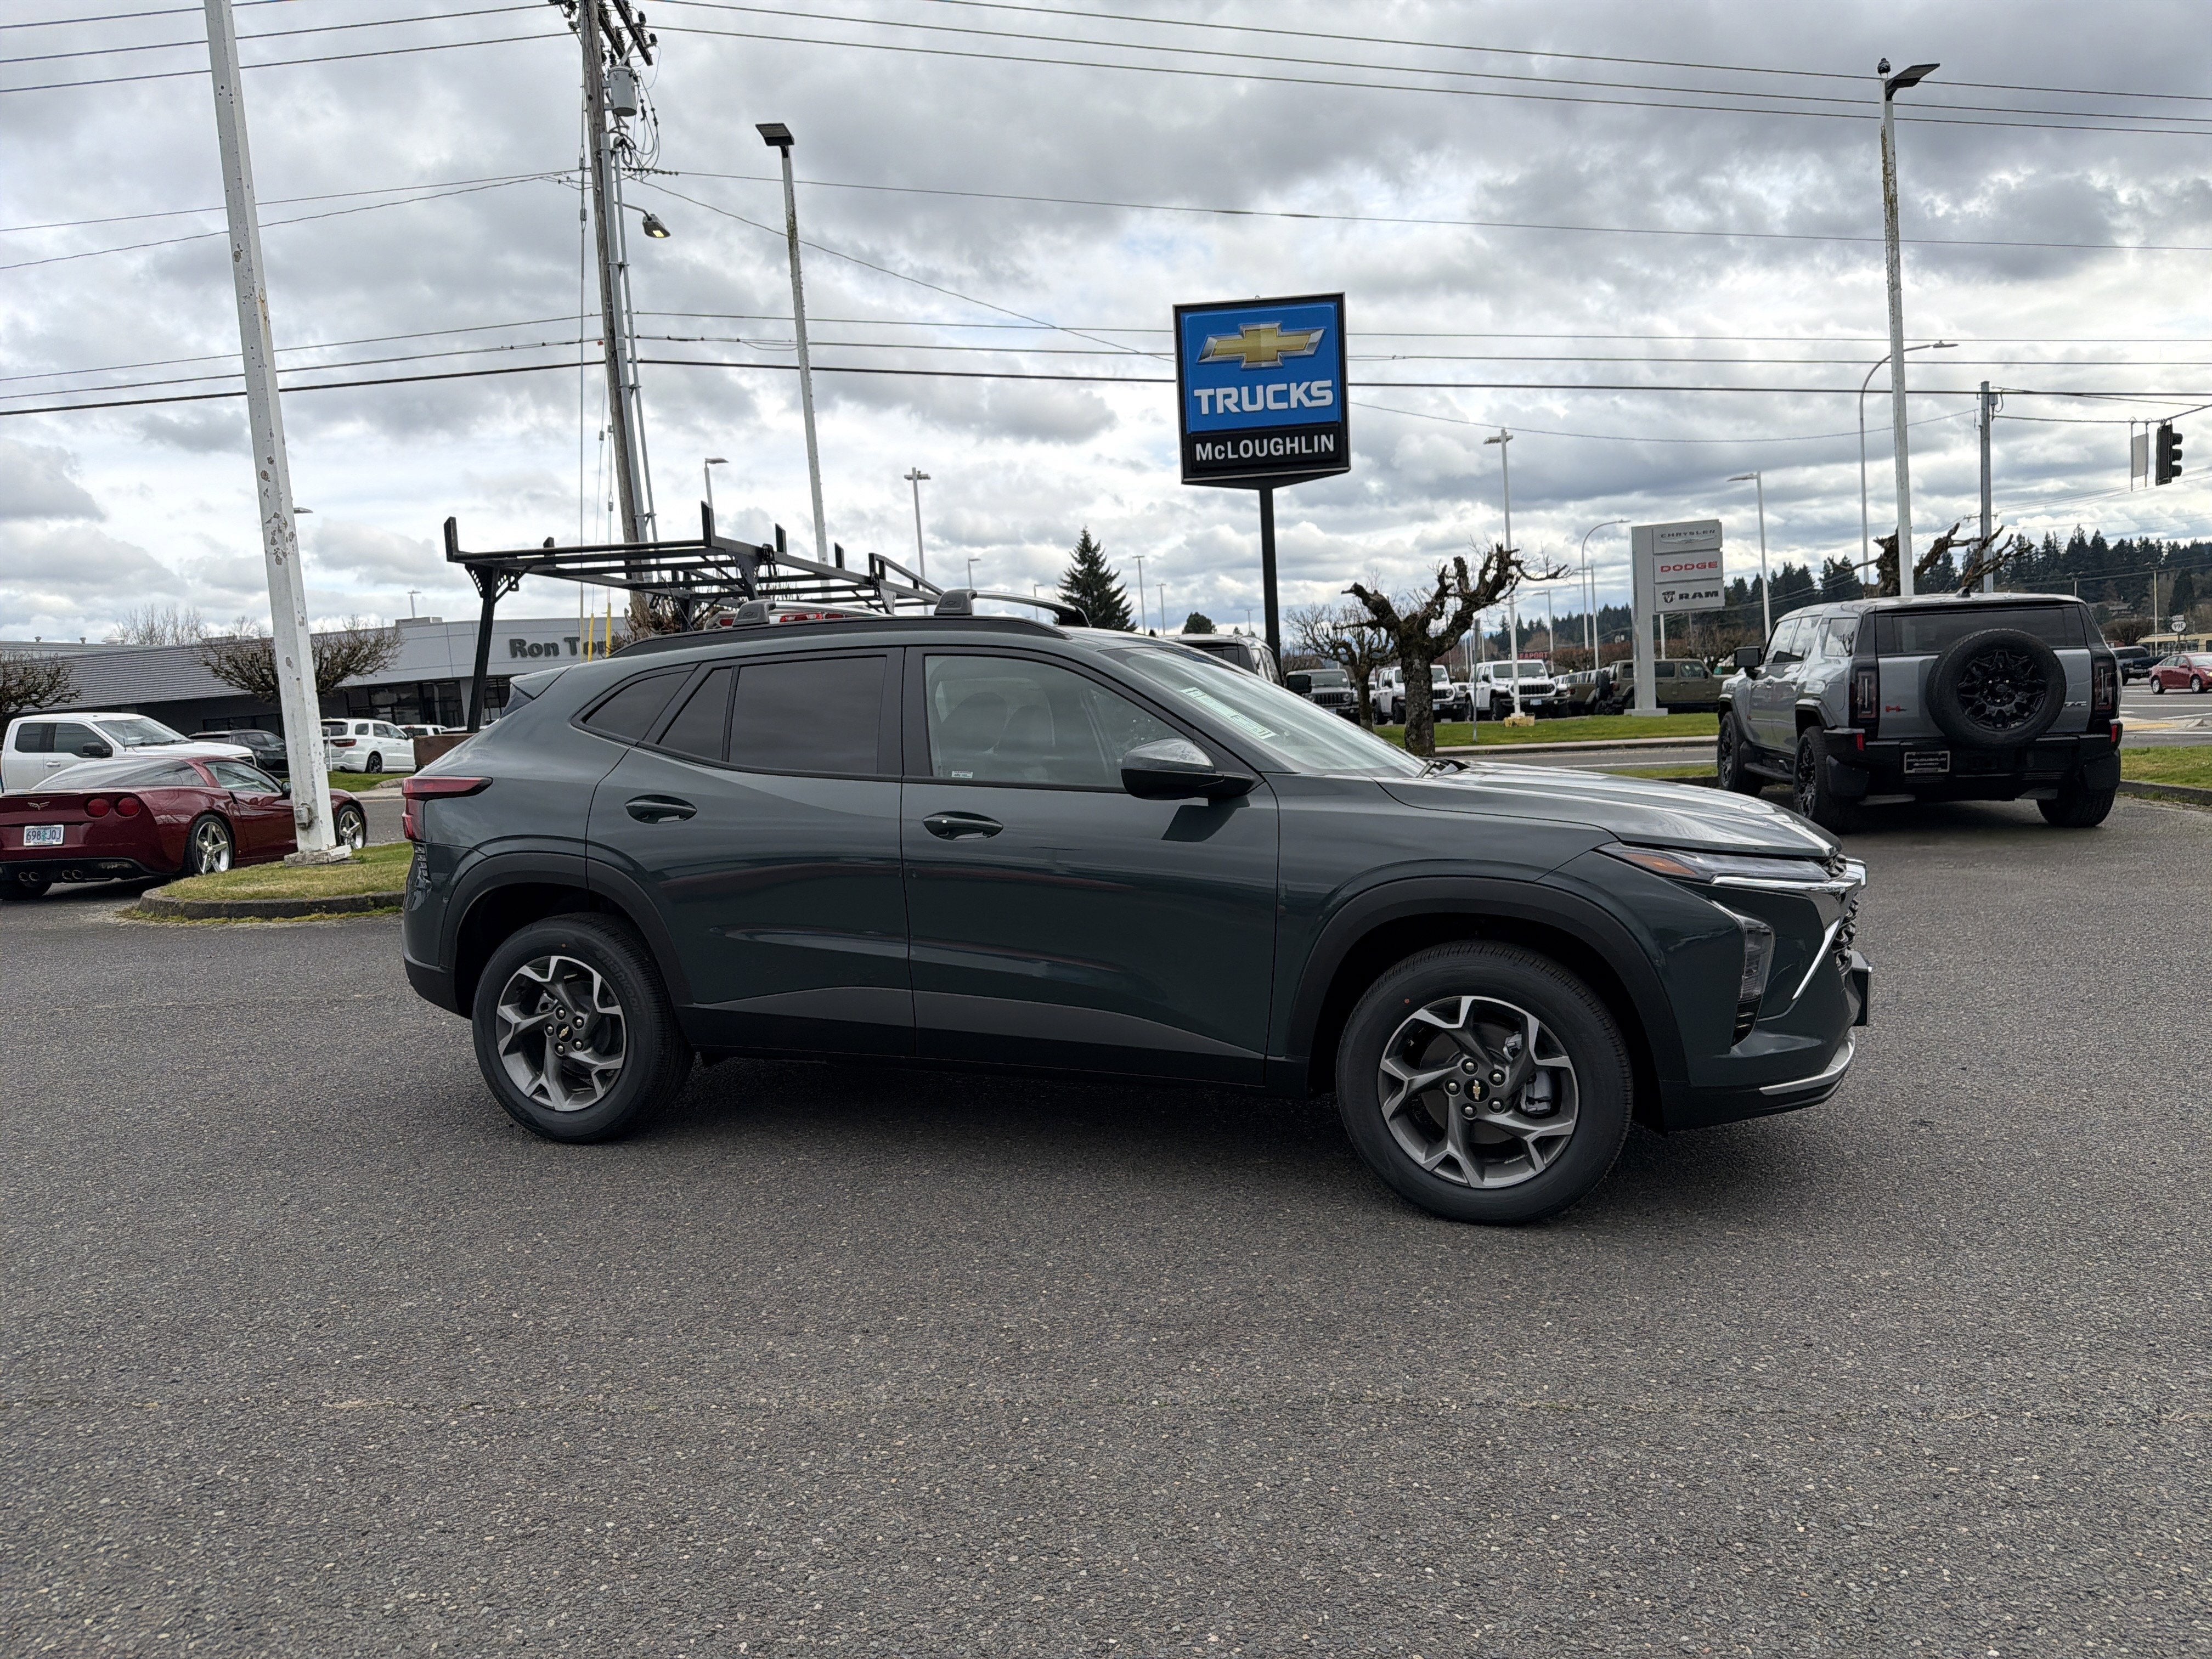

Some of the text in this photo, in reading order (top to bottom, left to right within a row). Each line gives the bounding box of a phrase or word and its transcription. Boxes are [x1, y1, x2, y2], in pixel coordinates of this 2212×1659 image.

[1194, 380, 1333, 415] TRUCKS
[1195, 434, 1334, 461] McLOUGHLIN
[1661, 529, 1716, 538] CHRYSLER
[1661, 561, 1718, 572] DODGE
[1679, 591, 1719, 600] RAM
[509, 639, 560, 658] Ron
[26, 830, 41, 840] 698
